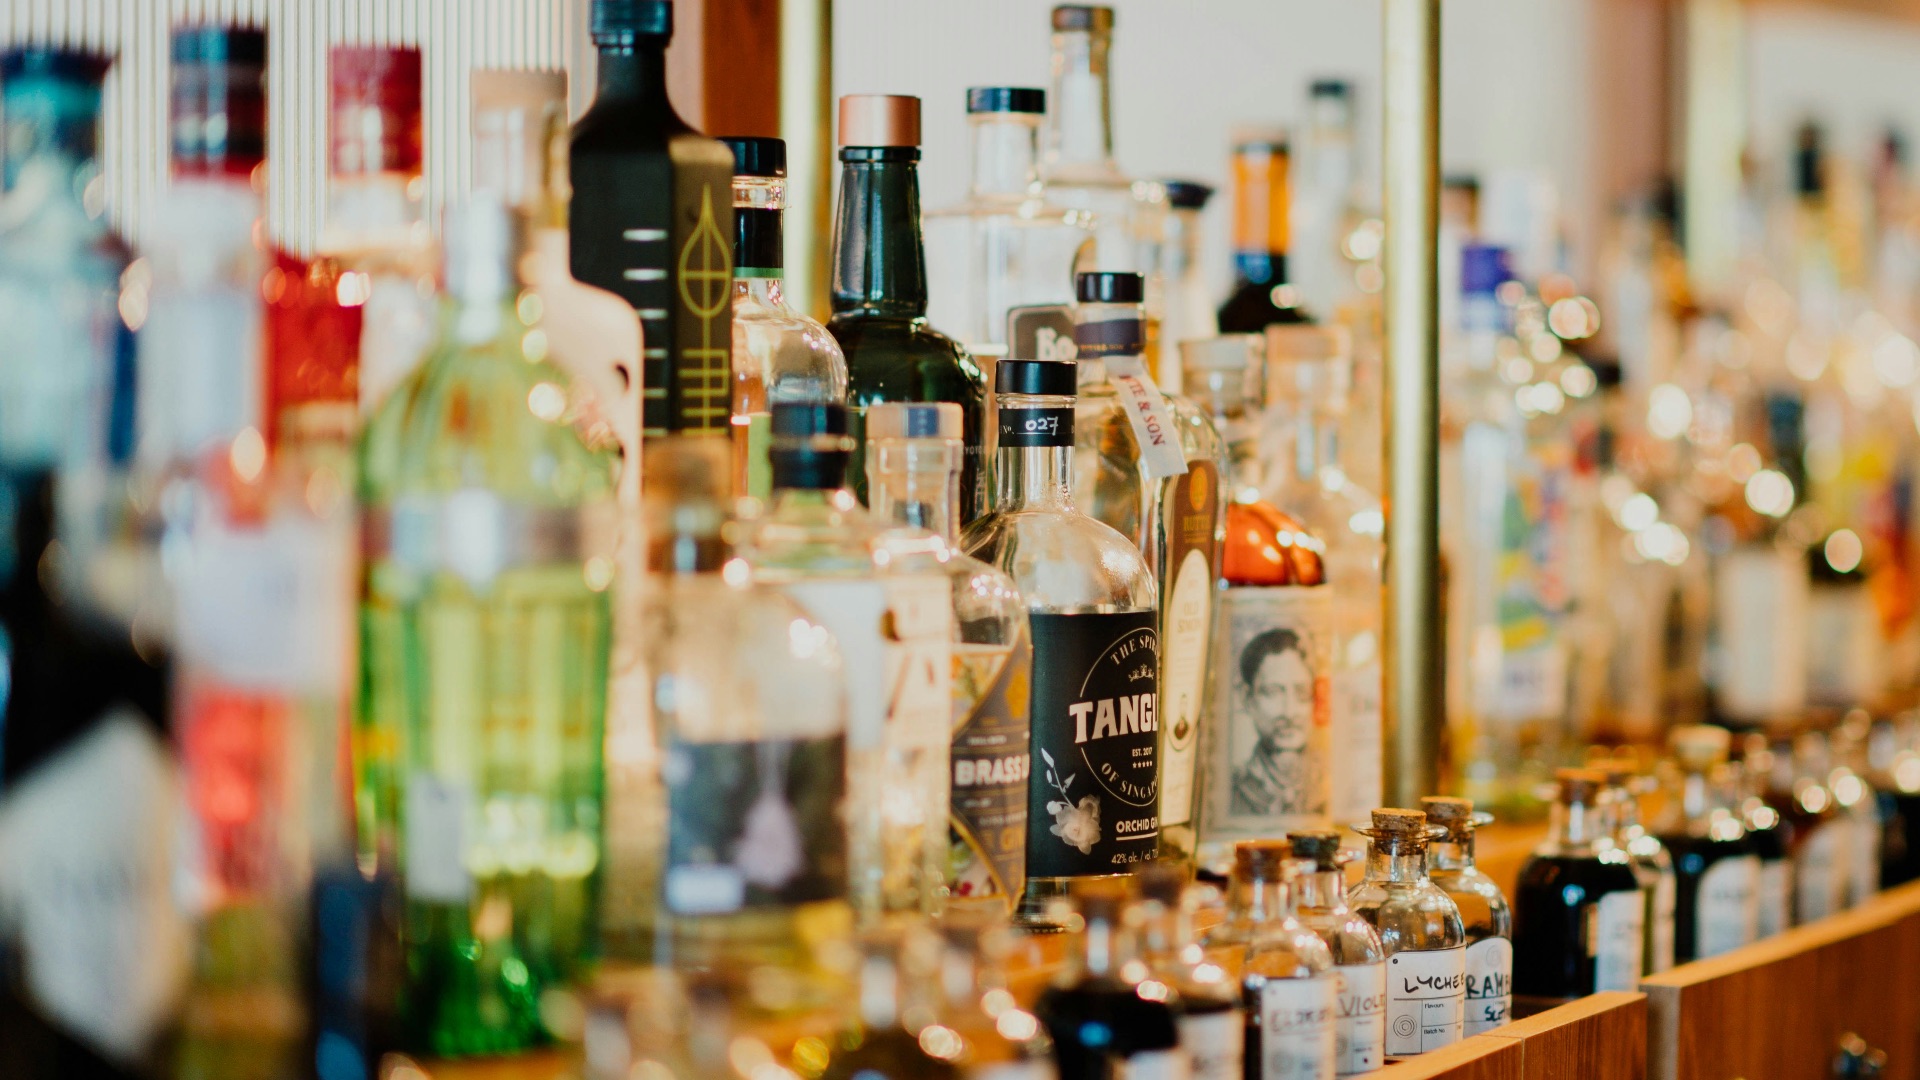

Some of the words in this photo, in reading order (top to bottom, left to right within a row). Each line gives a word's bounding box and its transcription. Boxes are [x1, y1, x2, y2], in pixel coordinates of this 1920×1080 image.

[1138, 401, 1151, 412] &
[1025, 416, 1058, 436] 027
[1143, 414, 1166, 445] SON
[1110, 638, 1137, 665] THE
[954, 755, 1021, 785] BRASS
[1101, 762, 1120, 782] OF
[1116, 818, 1150, 833] ORCHID
[1111, 853, 1127, 864] 42%
